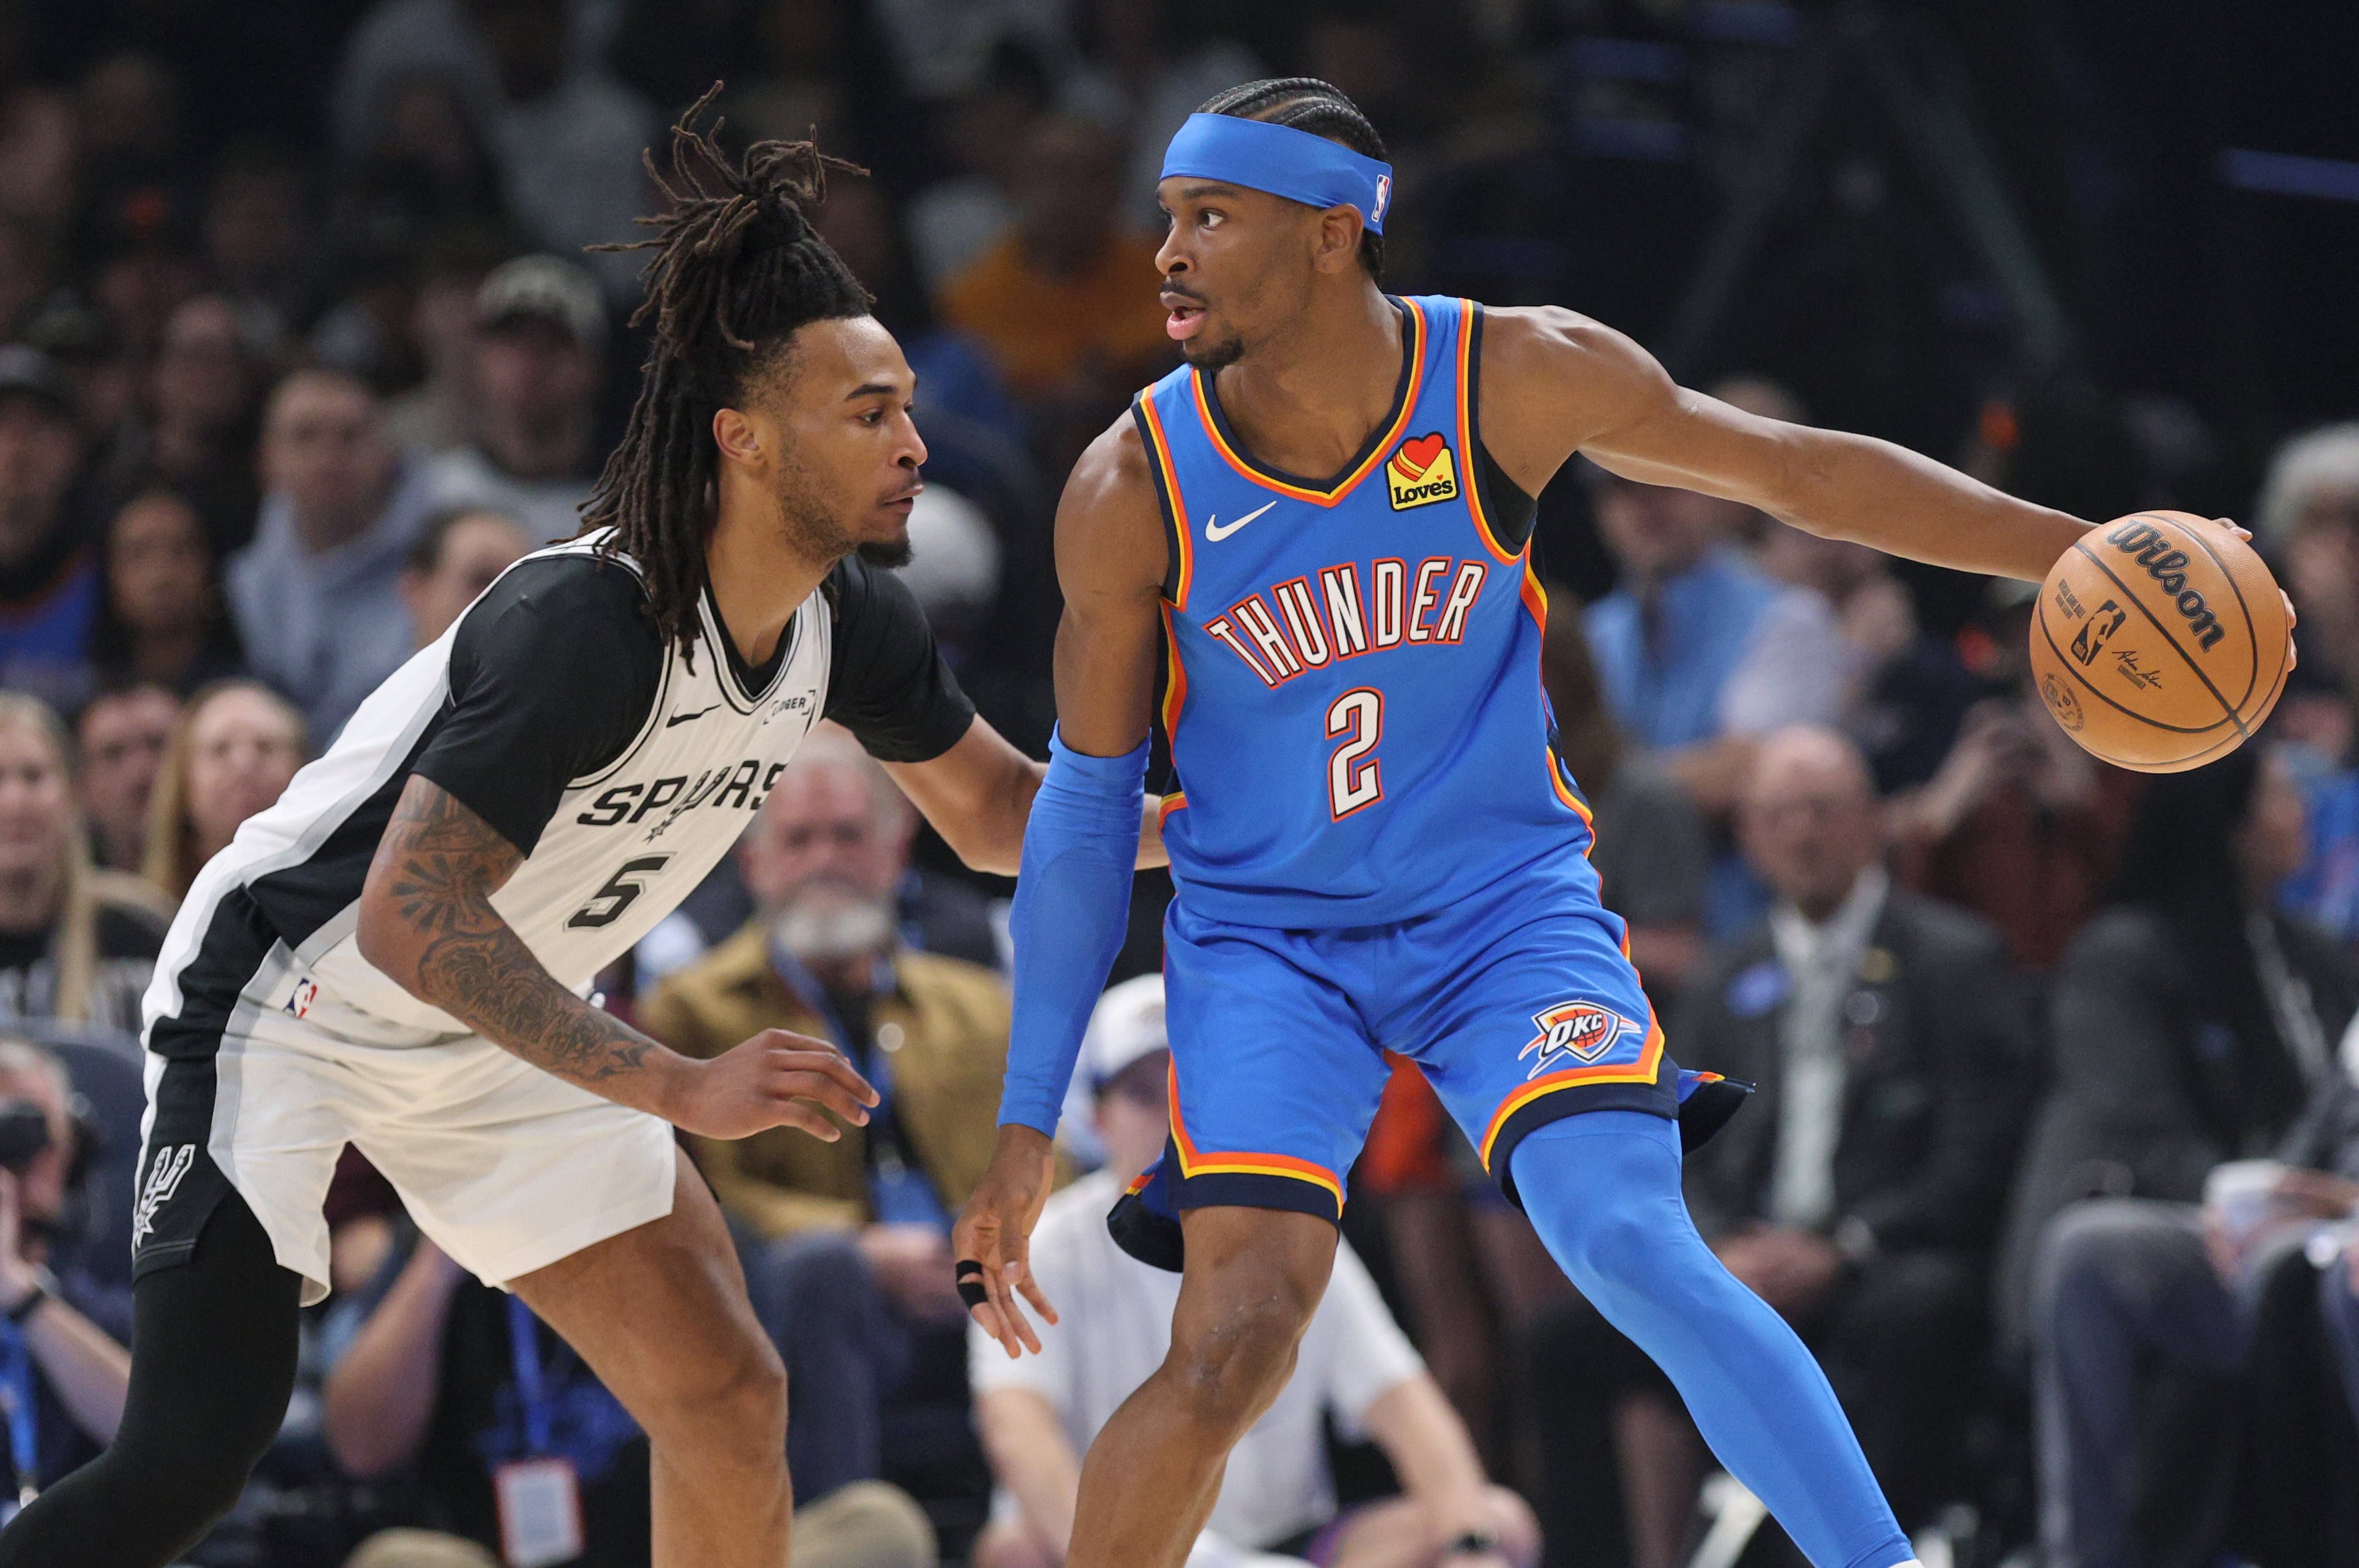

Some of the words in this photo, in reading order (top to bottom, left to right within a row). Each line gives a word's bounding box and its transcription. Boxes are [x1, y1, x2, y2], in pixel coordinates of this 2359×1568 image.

[1202, 556, 1488, 690] THUNDER
[2107, 520, 2224, 653] Wilson
[2072, 641, 2086, 658] NBA
[1325, 686, 1385, 823] 2
[562, 851, 678, 932] 5
[1541, 1013, 1604, 1057] OKC
